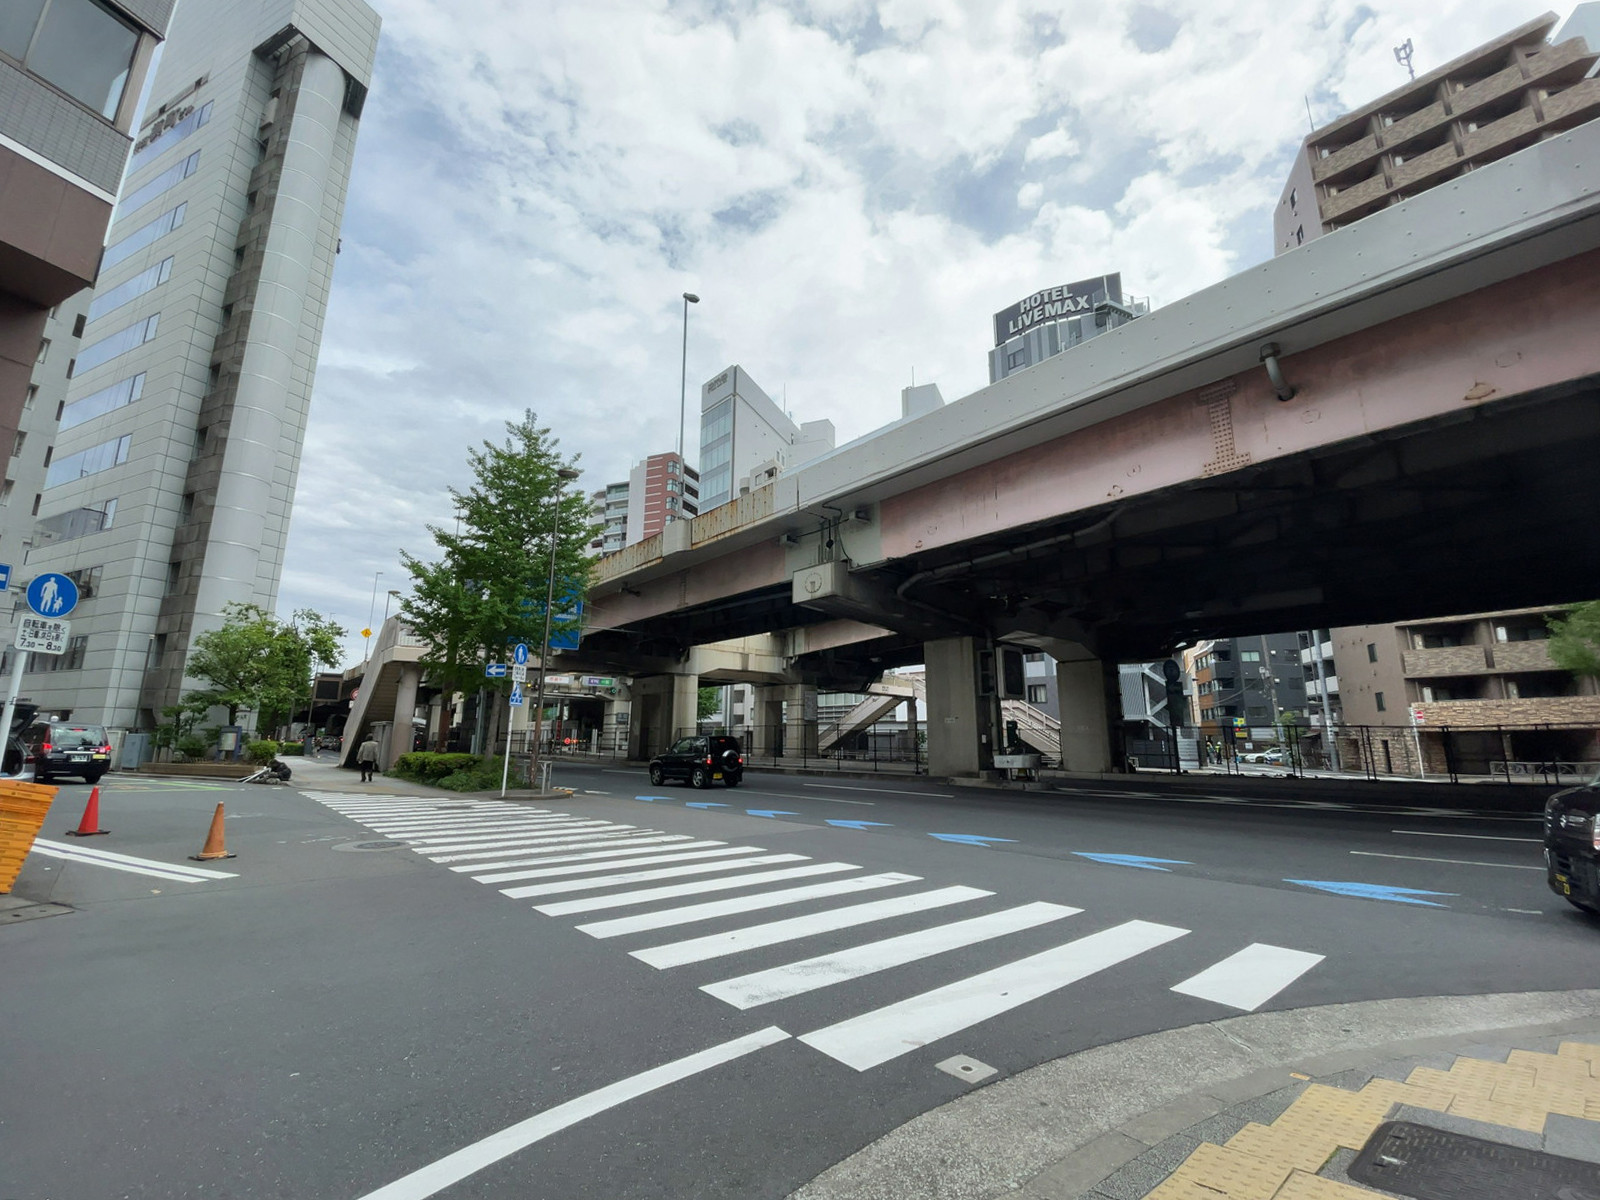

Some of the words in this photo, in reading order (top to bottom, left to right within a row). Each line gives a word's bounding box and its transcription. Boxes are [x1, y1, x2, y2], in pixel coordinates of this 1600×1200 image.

[1020, 285, 1073, 313] HOTEL
[23, 618, 66, 634] 自転車を除く
